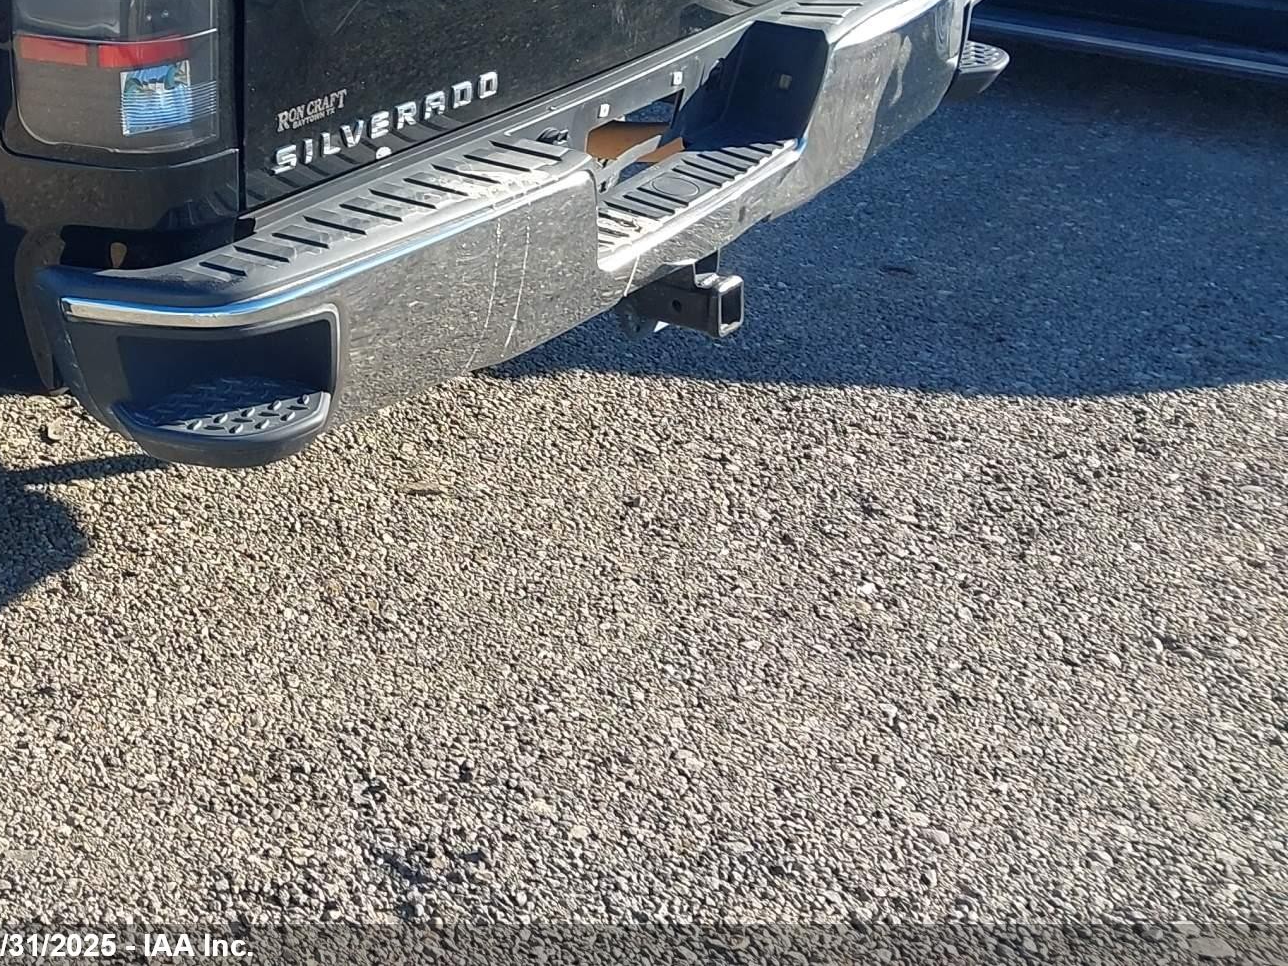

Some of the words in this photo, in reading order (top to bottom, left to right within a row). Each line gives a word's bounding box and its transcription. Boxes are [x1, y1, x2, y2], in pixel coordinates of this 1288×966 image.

[271, 71, 498, 175] SILVERADO
[277, 104, 306, 132] RON
[306, 88, 348, 116] CRAFT
